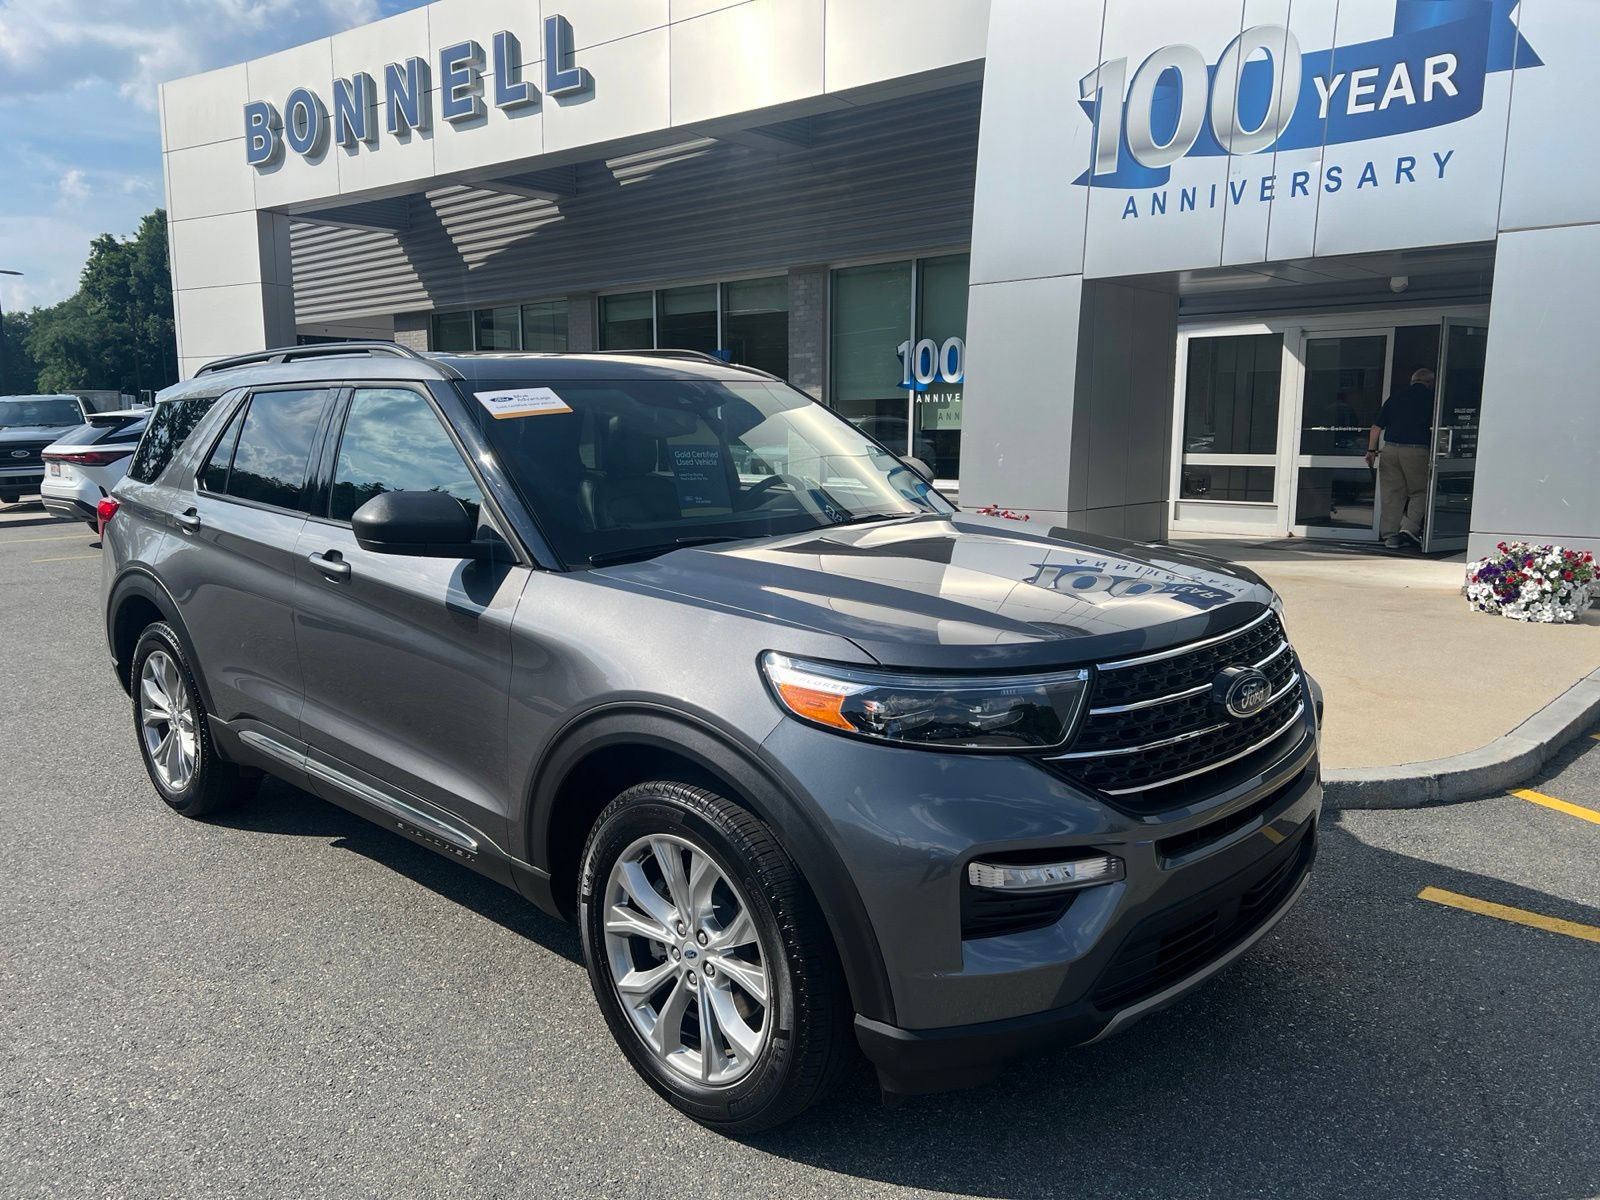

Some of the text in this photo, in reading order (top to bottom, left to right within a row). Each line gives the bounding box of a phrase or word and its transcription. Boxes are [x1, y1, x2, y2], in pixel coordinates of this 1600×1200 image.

[244, 14, 590, 169] BONNELL
[1079, 24, 1459, 176] 100 YEAR
[1122, 150, 1455, 220] ANNIVERSARY
[896, 337, 966, 385] 100
[674, 450, 719, 458] Gold Certified
[676, 458, 718, 466] Used Vehicle
